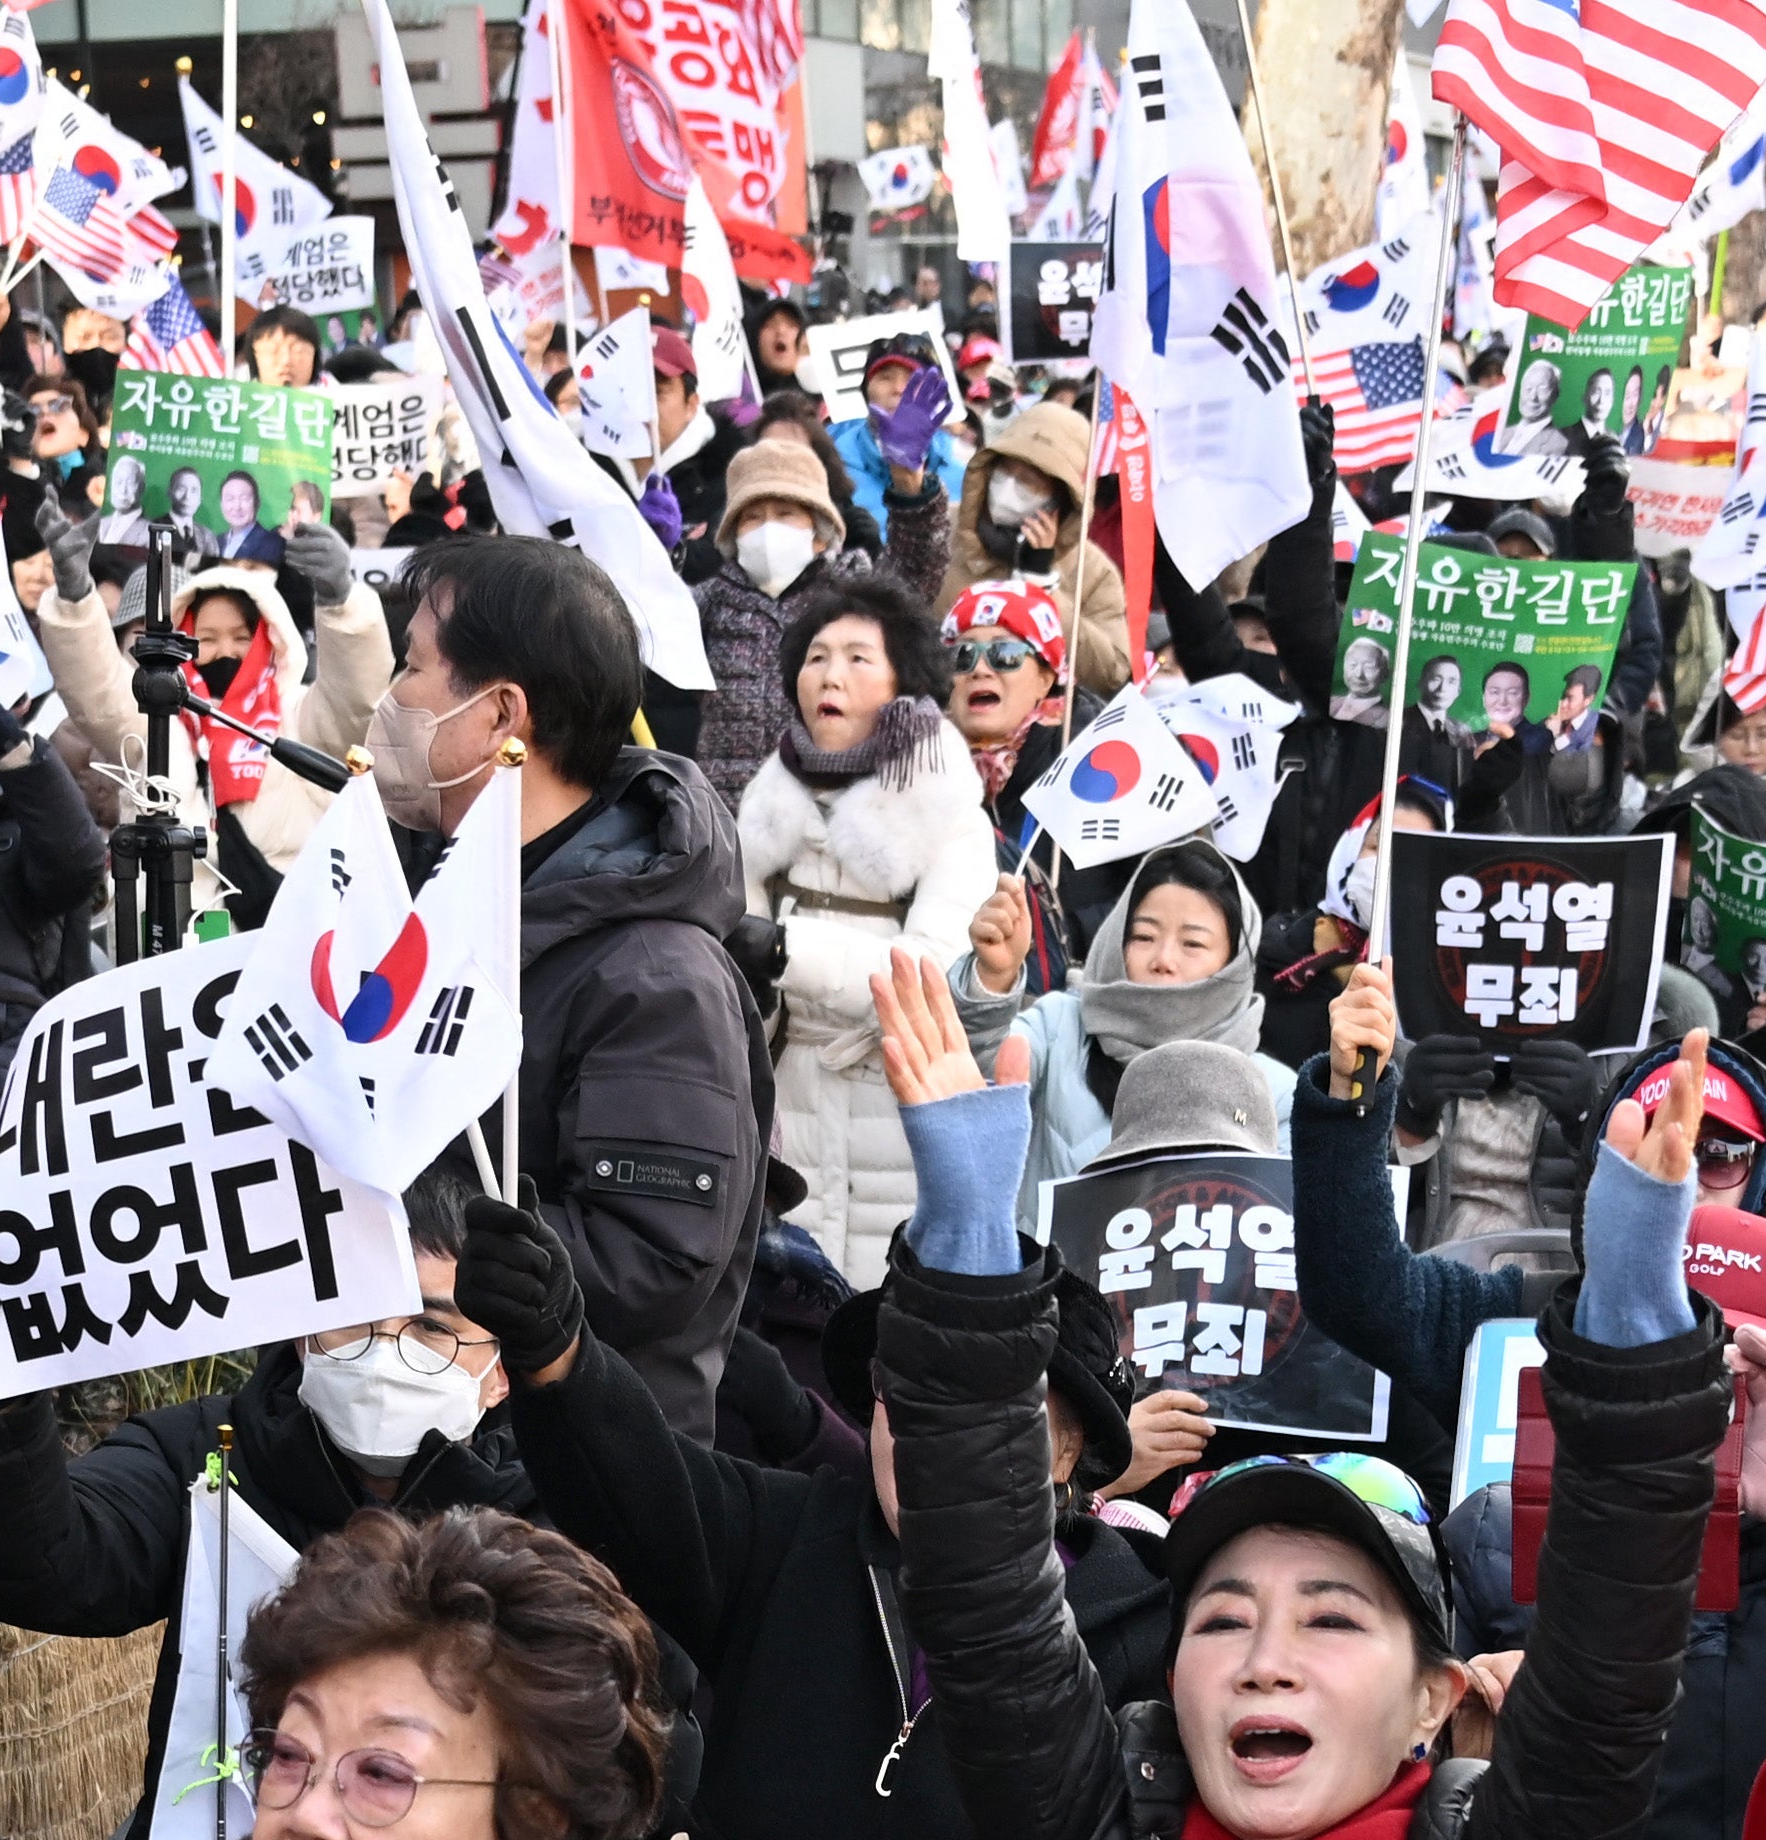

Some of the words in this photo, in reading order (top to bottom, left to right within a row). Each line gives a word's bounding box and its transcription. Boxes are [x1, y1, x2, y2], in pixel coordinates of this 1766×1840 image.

[120, 376, 332, 448] 자유한길단
[1363, 548, 1627, 625] 자유한길단
[1435, 875, 1614, 953] 윤석열
[1464, 963, 1579, 1028] 무죄
[635, 1174, 692, 1189] GEOGRAPHIC
[637, 1164, 682, 1178] NATIONAL
[1098, 1204, 1298, 1294] 윤석열
[1689, 1264, 1726, 1277] GOLF
[1695, 1244, 1762, 1273] PARK
[1131, 1301, 1267, 1378] 무죄
